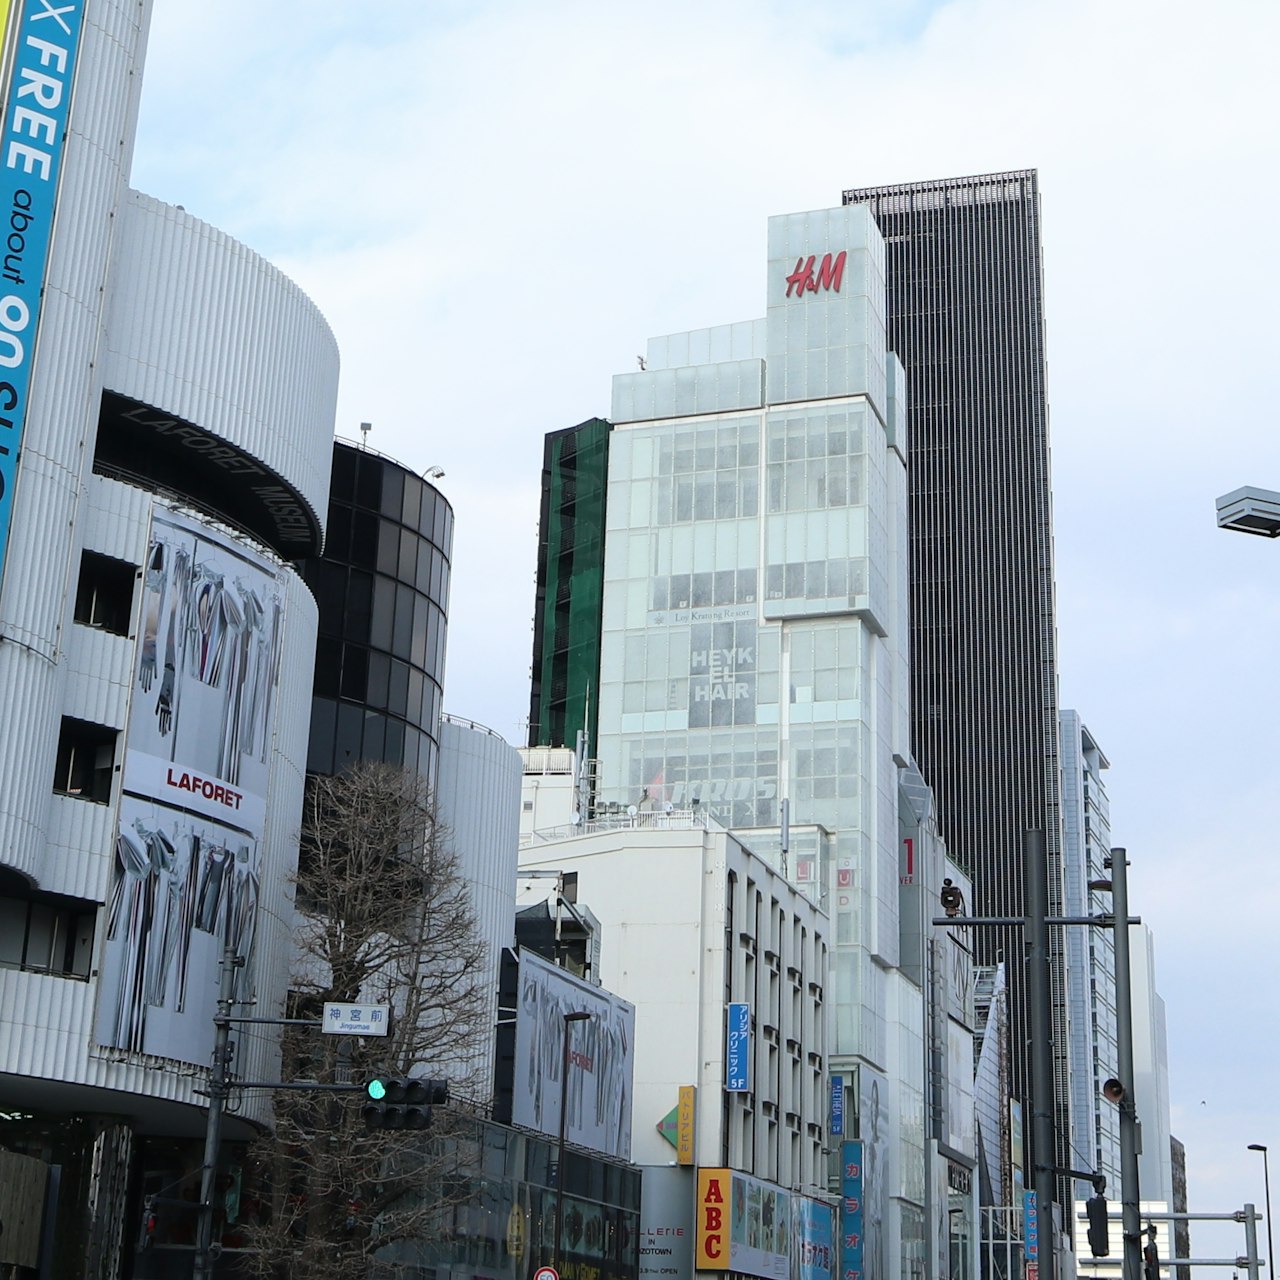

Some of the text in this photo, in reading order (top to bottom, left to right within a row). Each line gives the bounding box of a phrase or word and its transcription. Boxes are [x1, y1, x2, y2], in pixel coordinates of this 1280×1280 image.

[5, 34, 68, 181] FREE
[2, 188, 35, 284] about
[785, 250, 847, 298] H&M
[120, 407, 312, 543] LAFORET MUSEUM
[695, 683, 750, 702] HAIR
[167, 768, 243, 810] LAFORET
[329, 1008, 382, 1023] 神宮前
[340, 1023, 371, 1031] Jingumae
[739, 1005, 749, 1041] アリシア
[567, 1049, 595, 1074] AFORET
[729, 1031, 739, 1076] クリニック
[731, 1079, 746, 1089] 5F
[704, 1179, 724, 1259] ABC
[639, 1248, 672, 1256] ZOTOWN
[660, 1267, 679, 1275] OPEN
